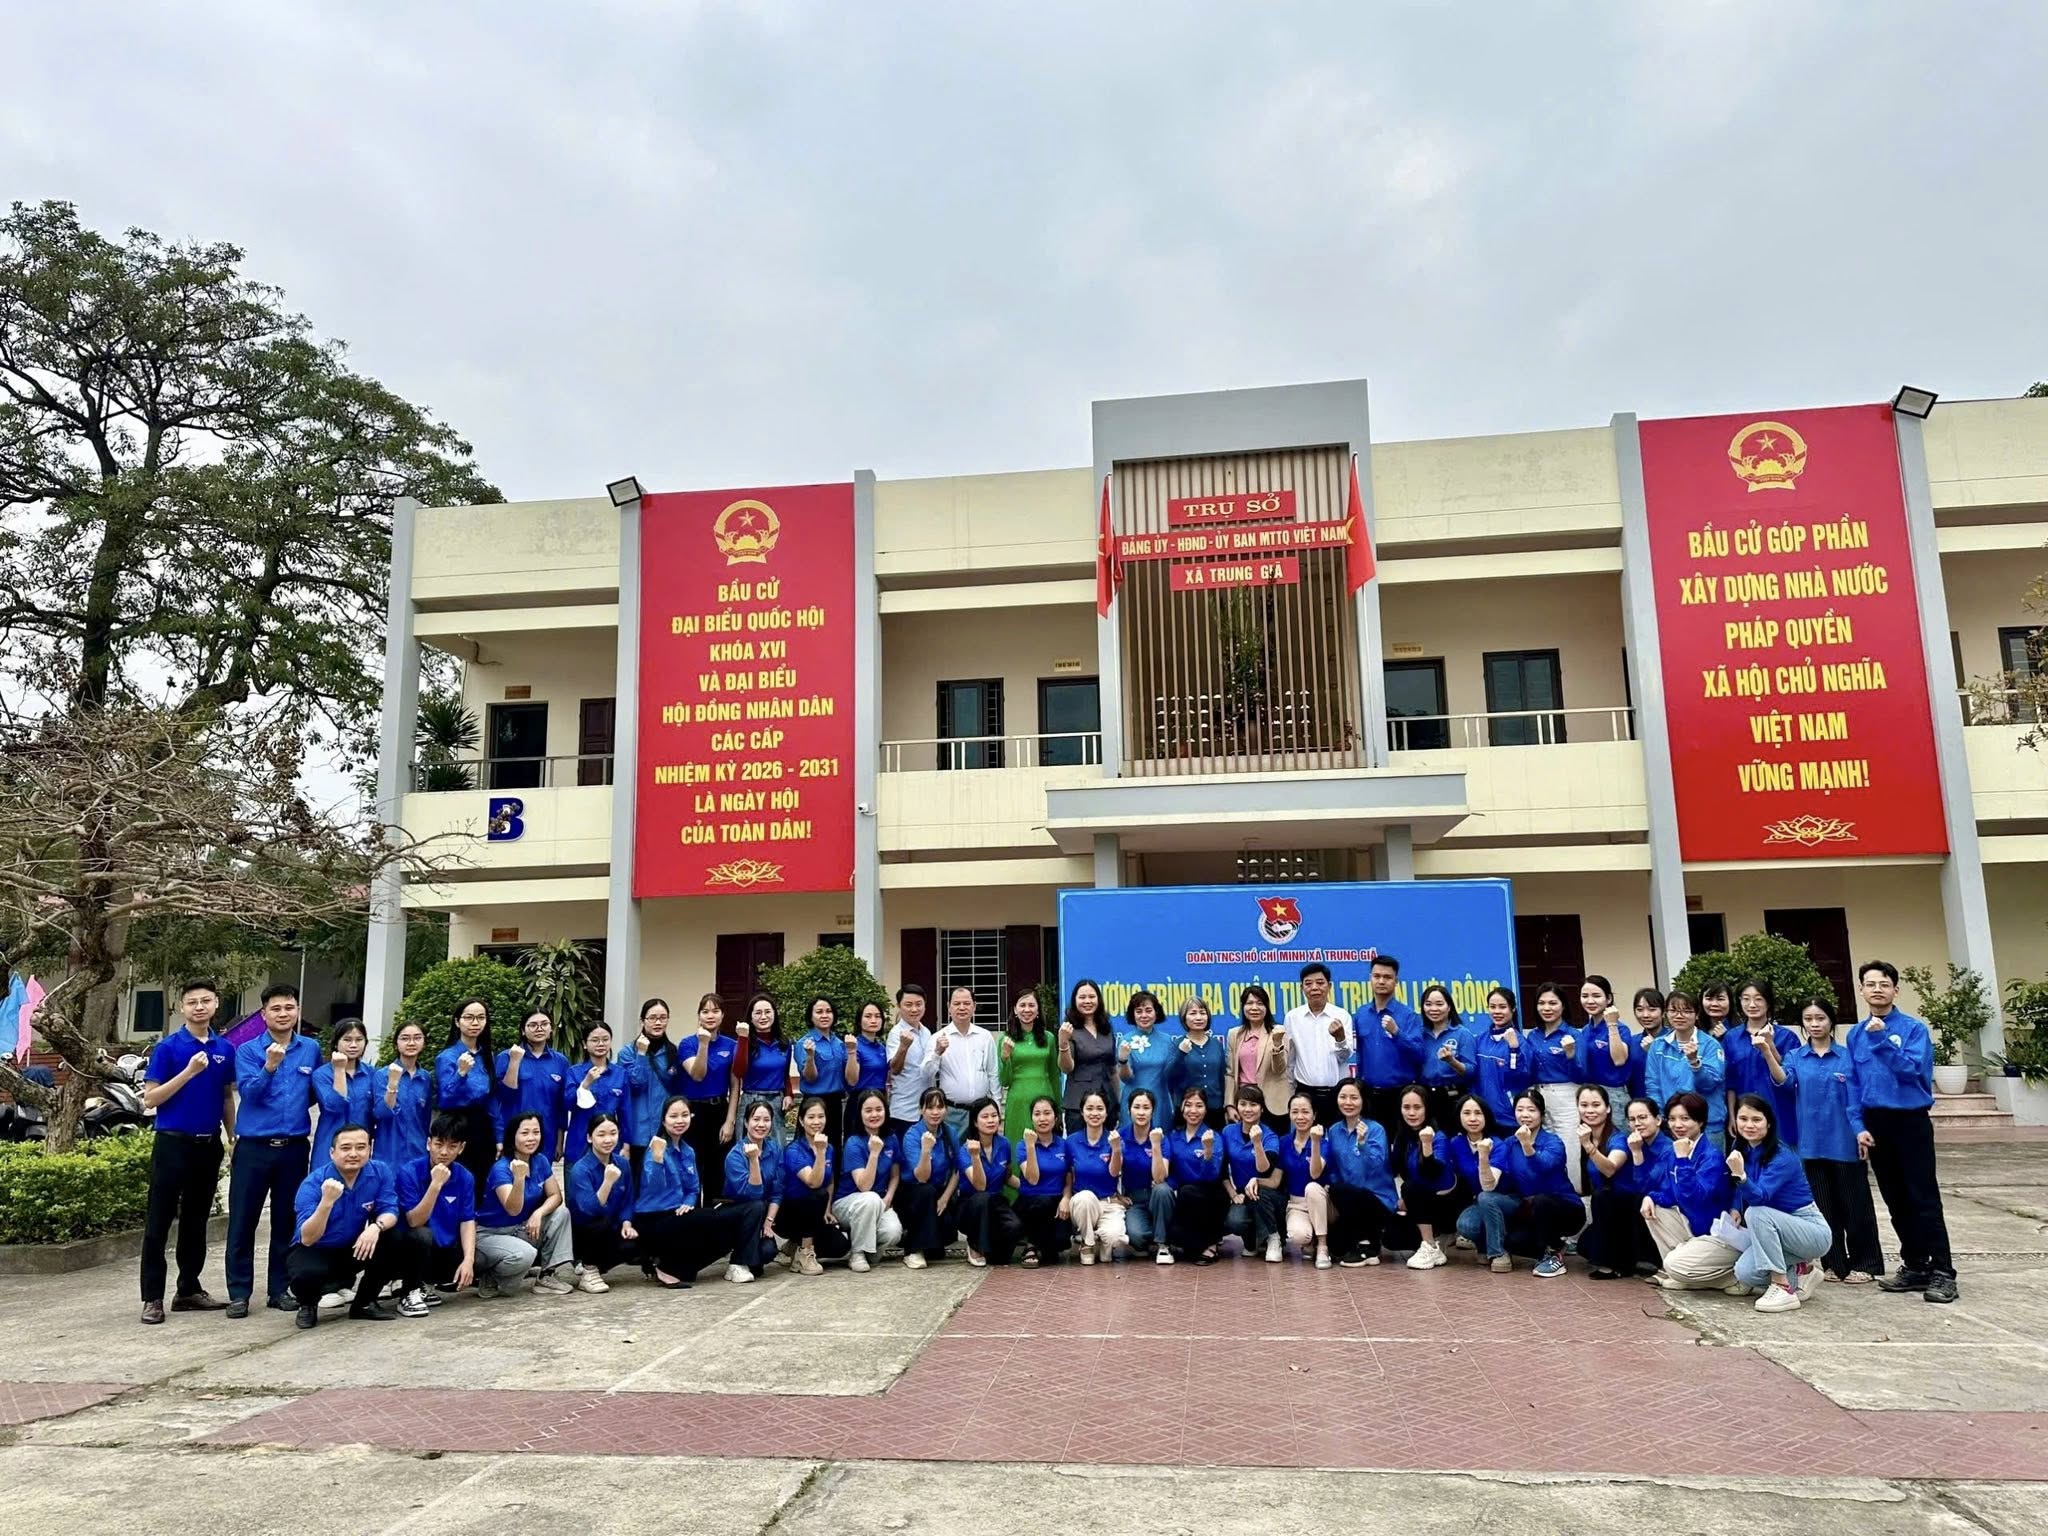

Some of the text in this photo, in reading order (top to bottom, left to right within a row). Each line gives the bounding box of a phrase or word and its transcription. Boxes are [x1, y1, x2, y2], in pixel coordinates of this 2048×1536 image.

[1183, 492, 1281, 518] TRỤ SỞ
[1121, 536, 1151, 556] ĐẢNG
[1153, 534, 1168, 554] ỦY
[1177, 536, 1207, 552] HĐND
[1215, 530, 1230, 549] ỦY
[1233, 532, 1257, 548] BAN
[1259, 529, 1290, 546] MTTQ
[1293, 526, 1317, 546] VIỆT
[1320, 525, 1348, 542] NAM
[1688, 512, 1869, 558] BẦU CỬ GÓP PHẦN
[718, 576, 780, 602] BẦU CỬ
[1185, 566, 1204, 585] XÃ
[1209, 566, 1253, 583] TRUNG
[1679, 562, 1889, 608] XÂY DỰNG NHÀ NƯỚC
[671, 605, 825, 638] ĐẠI BIỂU QUỐC HỘI
[1725, 608, 1853, 650] PHÁP QUYỀN
[710, 639, 786, 662] KHÓA XVI
[699, 663, 797, 694] VÀ ĐẠI BIỂU
[1702, 657, 1888, 702] XÃ HỘI CHỦ NGHĨA
[662, 694, 834, 727] HỘI ĐỒNG NHÂN DÂN
[711, 724, 784, 752] CÁC CẤP
[1749, 709, 1849, 749] VIỆT NAM
[655, 761, 710, 787] NHIỆM
[715, 759, 737, 782] KỲ
[741, 761, 783, 781] 2026
[799, 758, 839, 778] 2031
[1737, 758, 1871, 796] VỮNG MẠNH!
[695, 787, 799, 813] LÀ NGÀY HỘI
[487, 797, 526, 843] B
[681, 818, 812, 844] CỦA TOÀN DÂN!
[1186, 949, 1214, 964] ĐOÀN
[1215, 950, 1242, 963] TNCS
[1279, 949, 1307, 962] MINH
[1324, 949, 1358, 962] TRUNG
[1201, 983, 1225, 1015] RA
